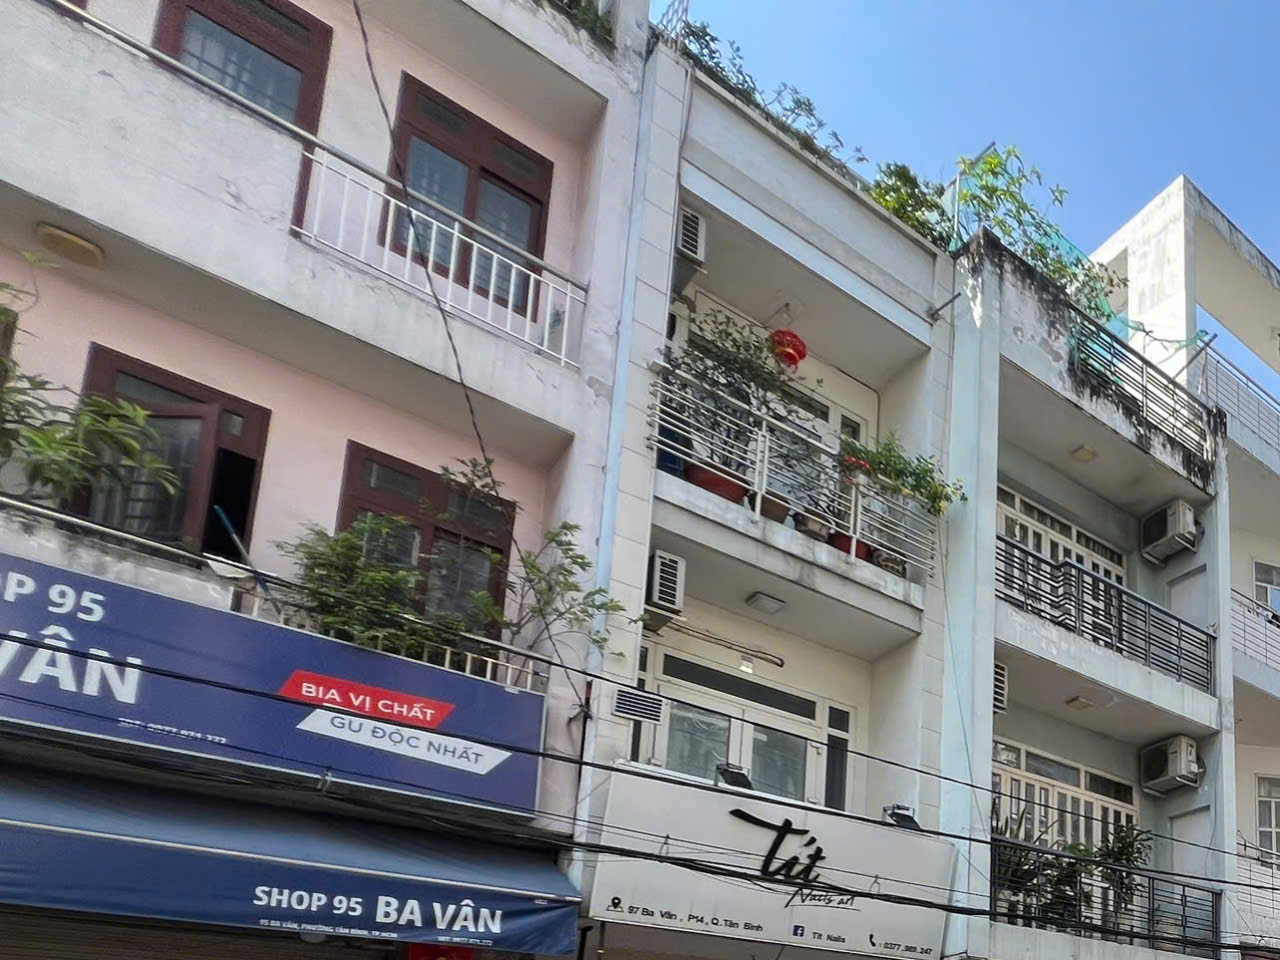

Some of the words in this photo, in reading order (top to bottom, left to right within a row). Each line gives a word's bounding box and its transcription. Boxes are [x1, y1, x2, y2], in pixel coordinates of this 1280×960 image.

[48, 584, 105, 622] 95
[301, 682, 341, 703] BIA
[348, 692, 371, 712] VỊ
[377, 701, 436, 722] CHẤT
[329, 715, 363, 734] GU
[371, 728, 421, 747] ĐỘC
[426, 740, 484, 766] NHẤT
[253, 885, 328, 912] SHOP
[332, 895, 363, 916] 95
[375, 895, 423, 927] BA
[432, 899, 503, 934] VÂN
[627, 905, 641, 915] 97
[641, 907, 655, 917] Ba
